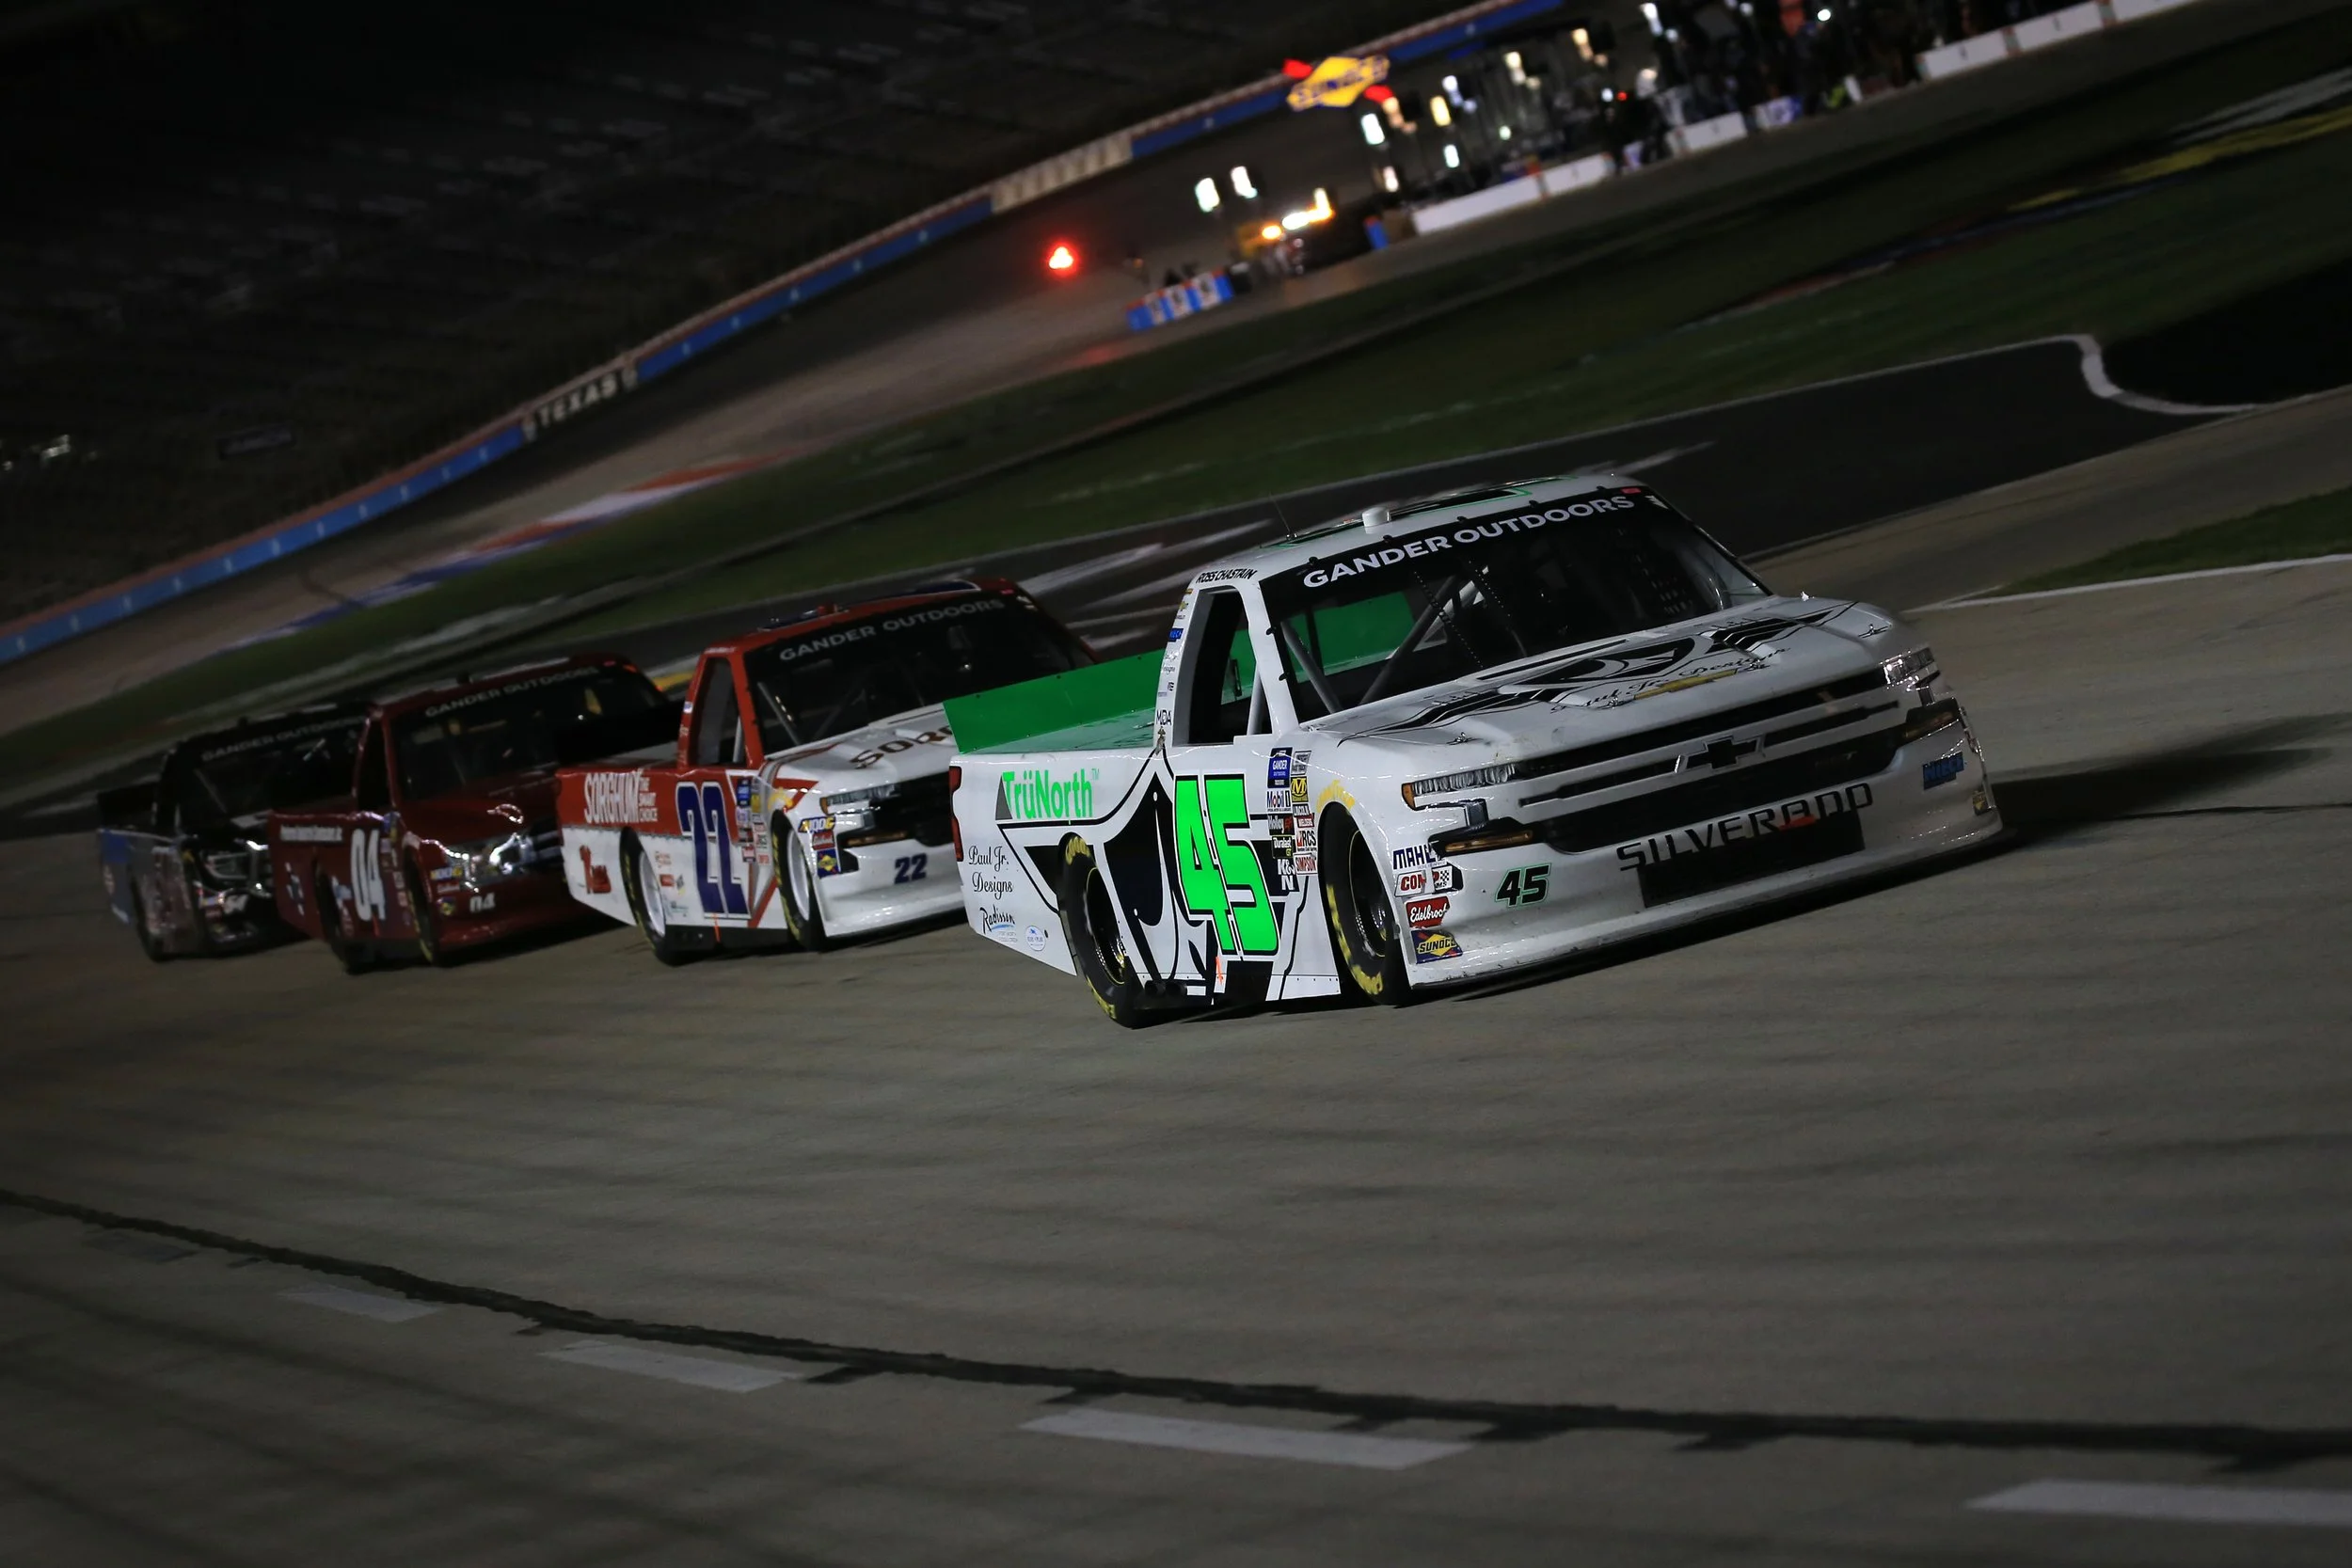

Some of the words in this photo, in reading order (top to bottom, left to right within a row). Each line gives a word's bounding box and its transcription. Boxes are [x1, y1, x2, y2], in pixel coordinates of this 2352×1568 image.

[538, 372, 618, 428] TEXAS
[1303, 535, 1452, 588] GANDER
[1454, 496, 1635, 545] OUTDOORS
[1195, 571, 1218, 583] ROSS
[1215, 568, 1258, 581] CHASTAIN
[779, 626, 876, 661] GANDER
[882, 598, 1006, 631] OUTDOORS
[425, 689, 501, 718] GANDER
[502, 667, 599, 695] OUTDOORS
[850, 724, 952, 769] SOR
[1272, 760, 1288, 770] GANDER
[584, 769, 643, 824] SORGHUM
[1267, 790, 1285, 808] Mobil
[1273, 837, 1292, 848] Duralast
[1616, 783, 1873, 871] SILVERADO
[675, 782, 751, 919] 22
[894, 853, 928, 884] 22
[968, 846, 992, 865] Paul
[993, 847, 1009, 871] Jr.
[1175, 775, 1279, 956] 45
[1295, 856, 1316, 871] SIMPSON
[1392, 843, 1441, 870] MAHL
[351, 828, 386, 922] 04
[972, 872, 1013, 900] Designs
[1495, 863, 1551, 908] 45
